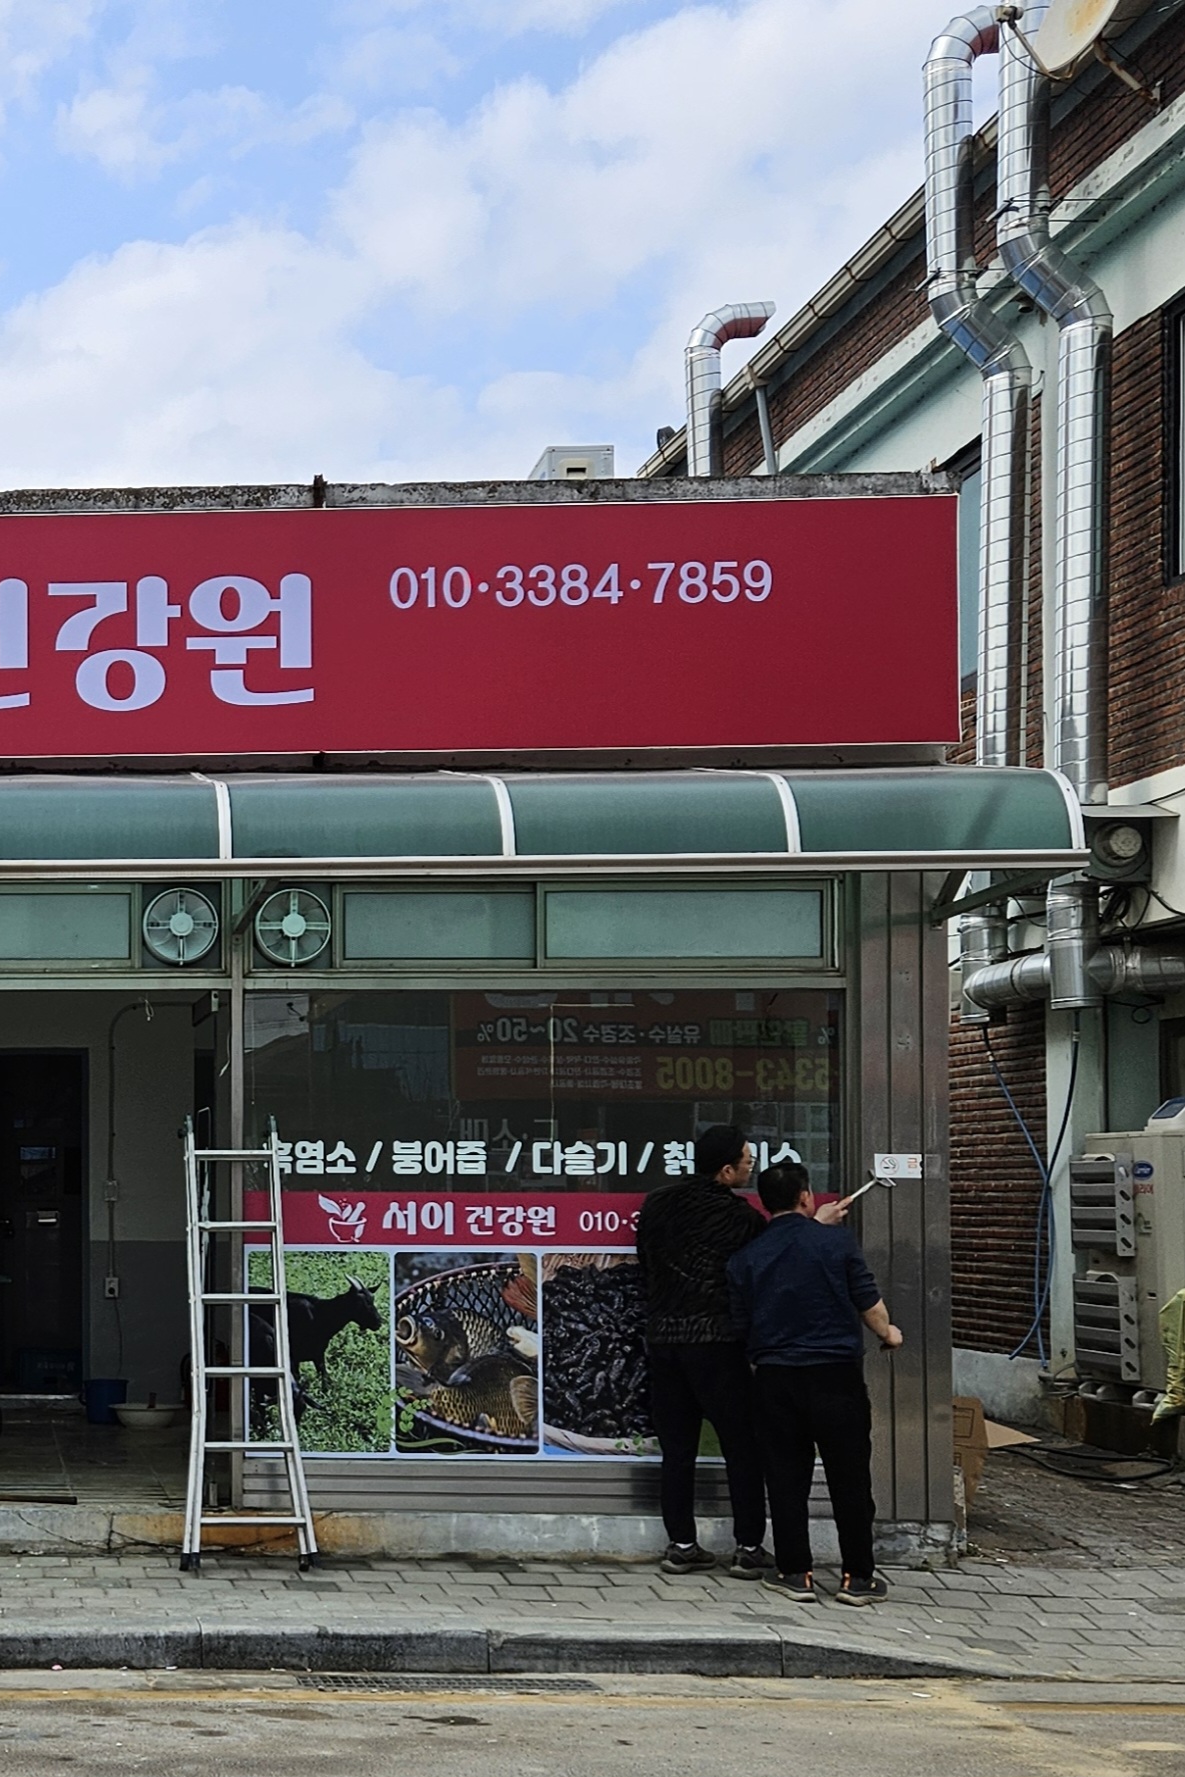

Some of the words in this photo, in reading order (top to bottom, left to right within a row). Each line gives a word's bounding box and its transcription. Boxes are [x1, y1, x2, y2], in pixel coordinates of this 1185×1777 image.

[391, 1139, 488, 1175] 붕어즙
[531, 1140, 628, 1176] 다슬기
[662, 1140, 696, 1176] 칡
[381, 1200, 455, 1236] 서이
[464, 1205, 557, 1237] 건강원
